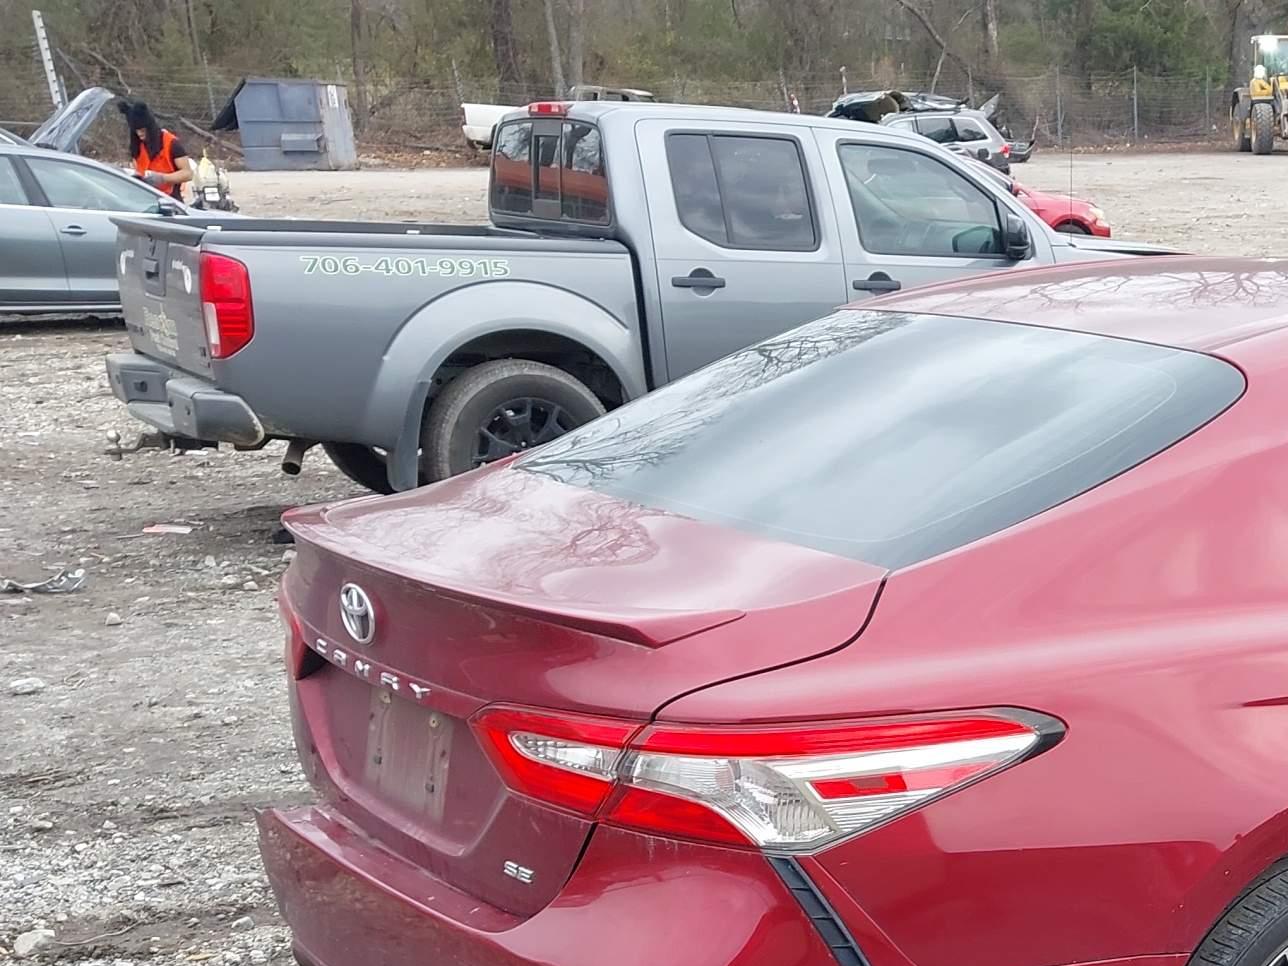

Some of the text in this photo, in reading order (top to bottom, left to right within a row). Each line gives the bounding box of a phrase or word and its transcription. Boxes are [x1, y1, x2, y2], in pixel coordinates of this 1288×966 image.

[300, 256, 510, 276] 706-401-9915
[316, 638, 431, 699] CAMRY
[504, 860, 535, 883] SE
